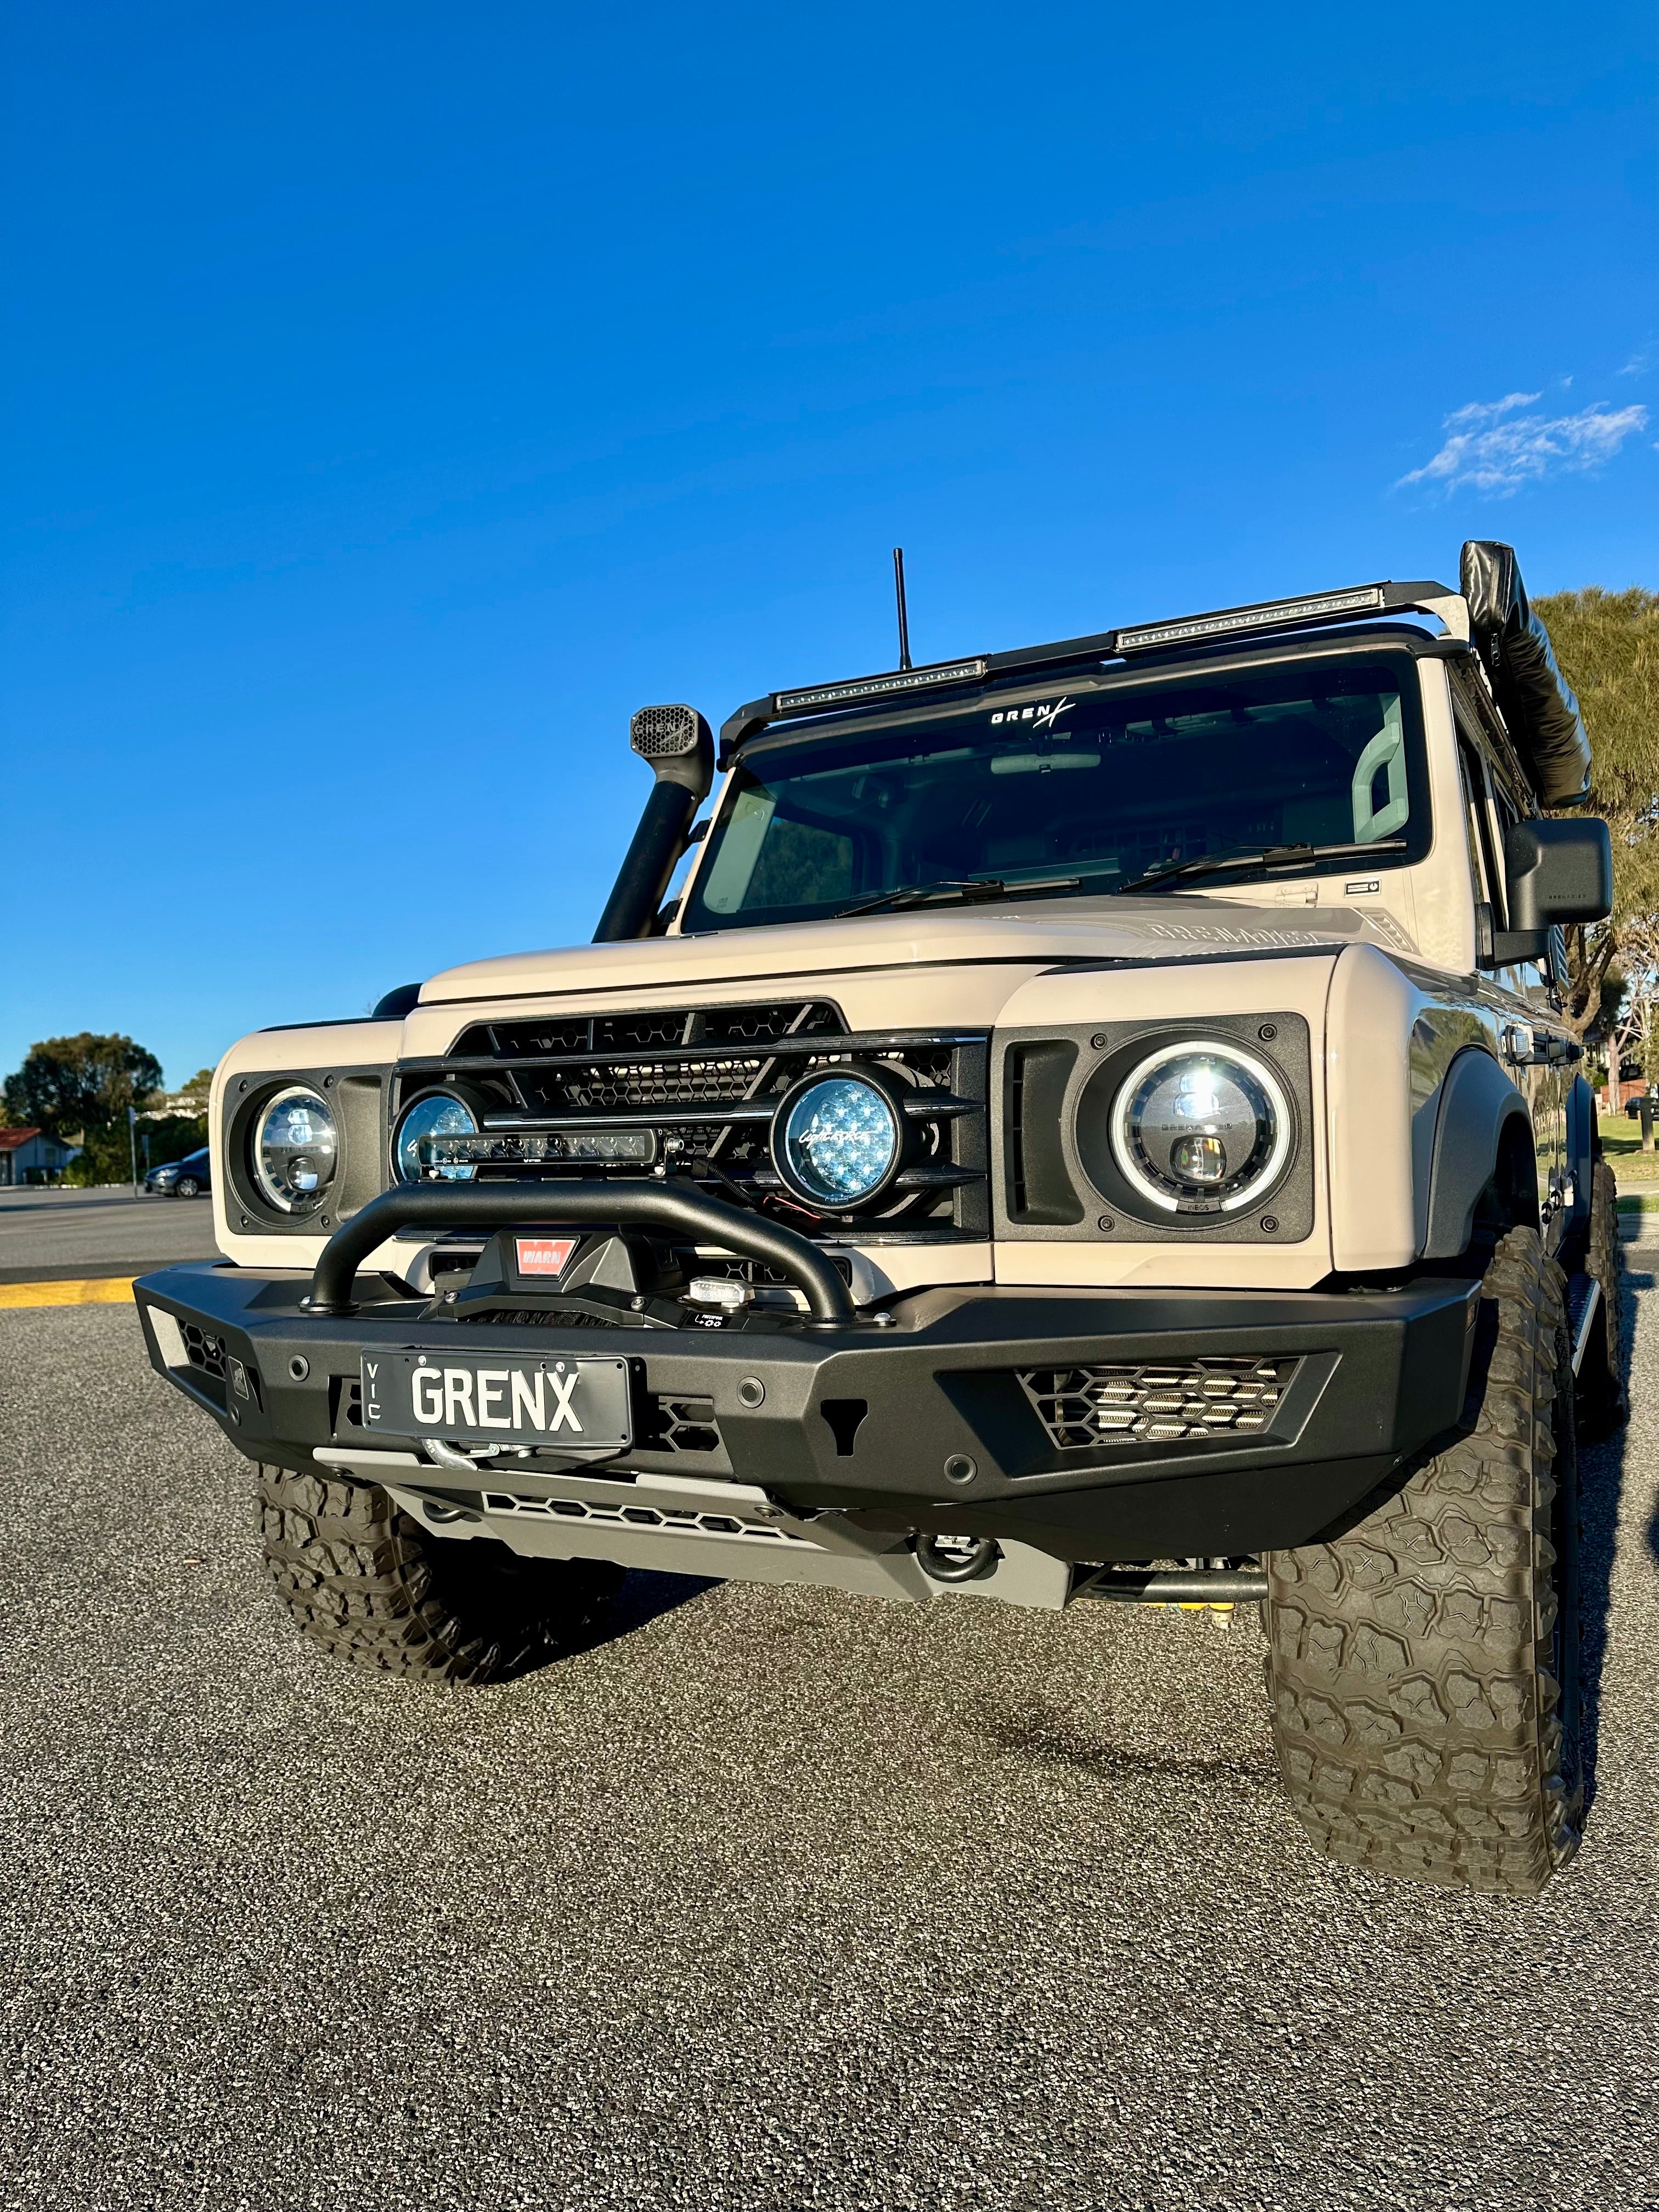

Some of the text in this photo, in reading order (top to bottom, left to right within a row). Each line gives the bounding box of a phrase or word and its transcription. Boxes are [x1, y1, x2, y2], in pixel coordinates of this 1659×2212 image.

[991, 696, 1076, 729] GRENX
[523, 1251, 561, 1264] WARN
[366, 1362, 381, 1420] VIC
[411, 1367, 584, 1432] GRENX
